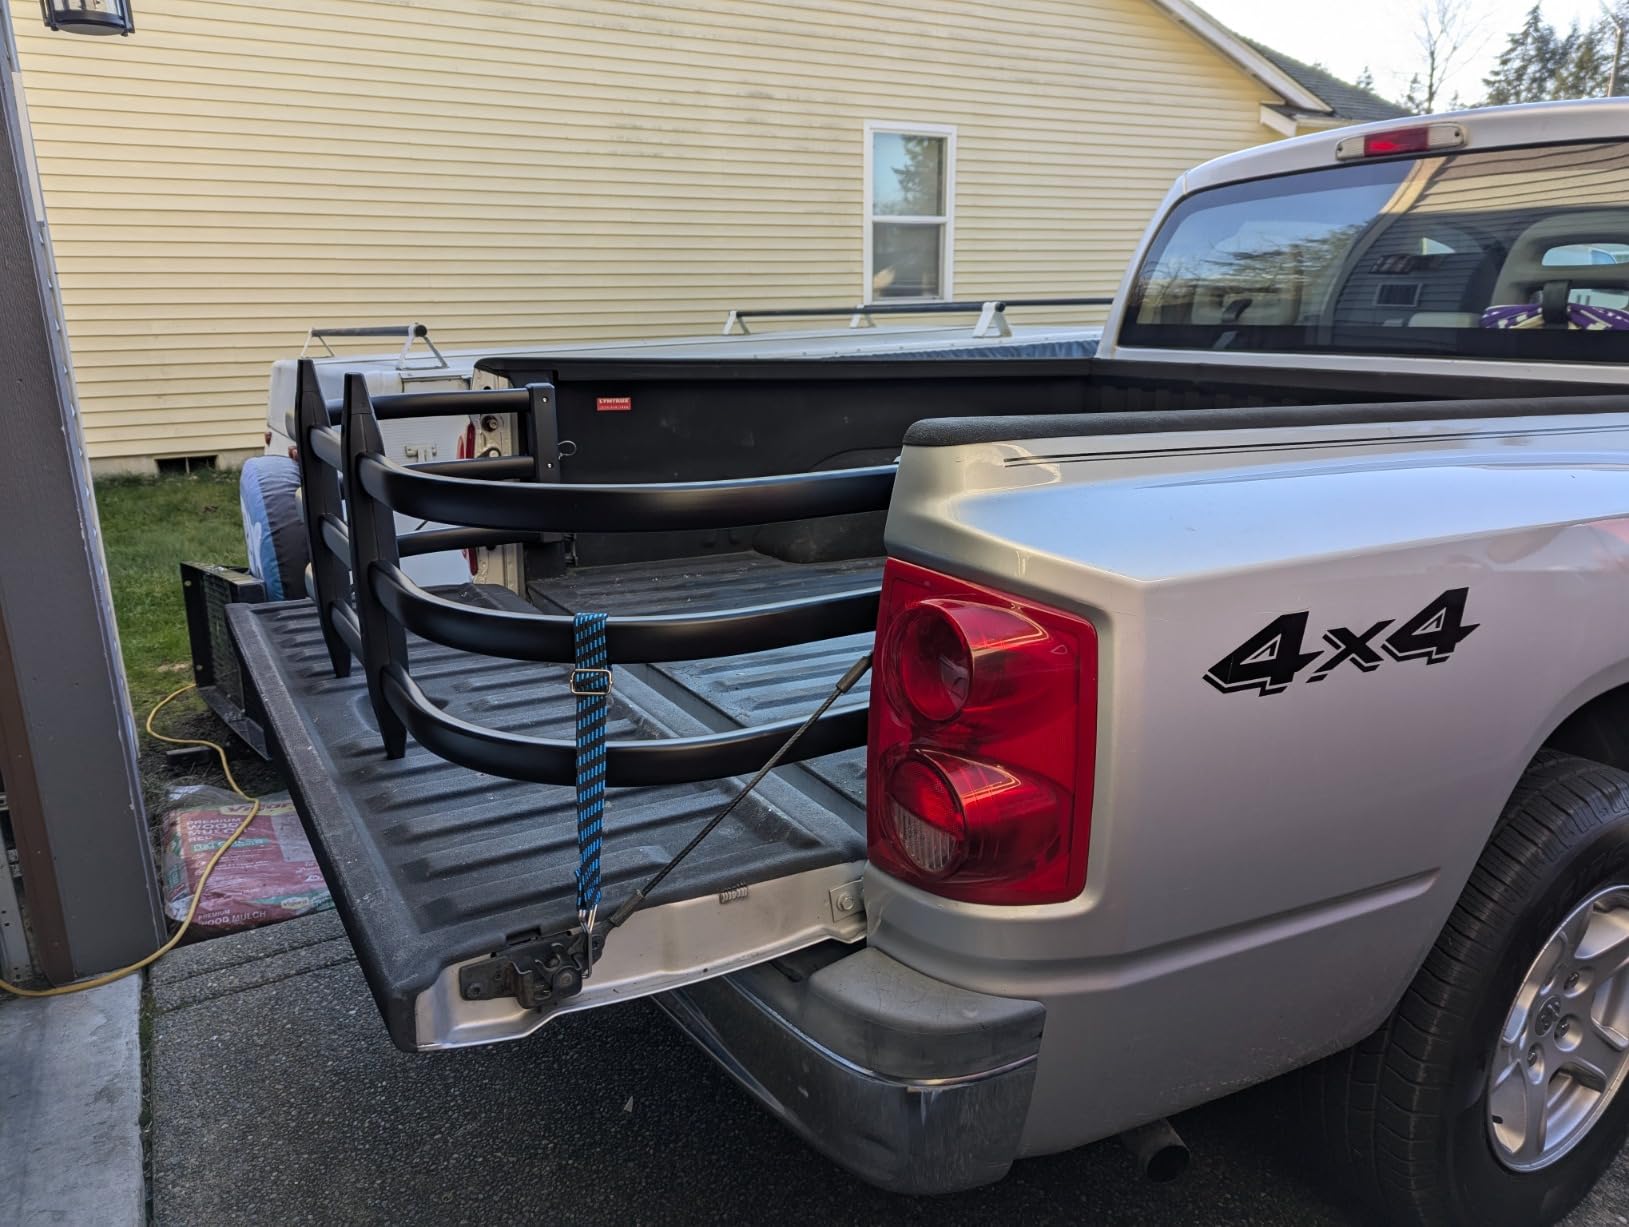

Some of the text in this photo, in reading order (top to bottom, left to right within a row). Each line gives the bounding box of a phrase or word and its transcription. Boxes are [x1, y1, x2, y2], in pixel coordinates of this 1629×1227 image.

[1202, 587, 1481, 697] 4x4
[186, 818, 241, 826] PREMIUM
[187, 823, 240, 831] WOOD
[198, 909, 231, 920] PREMIUM
[231, 911, 267, 924] MULCH
